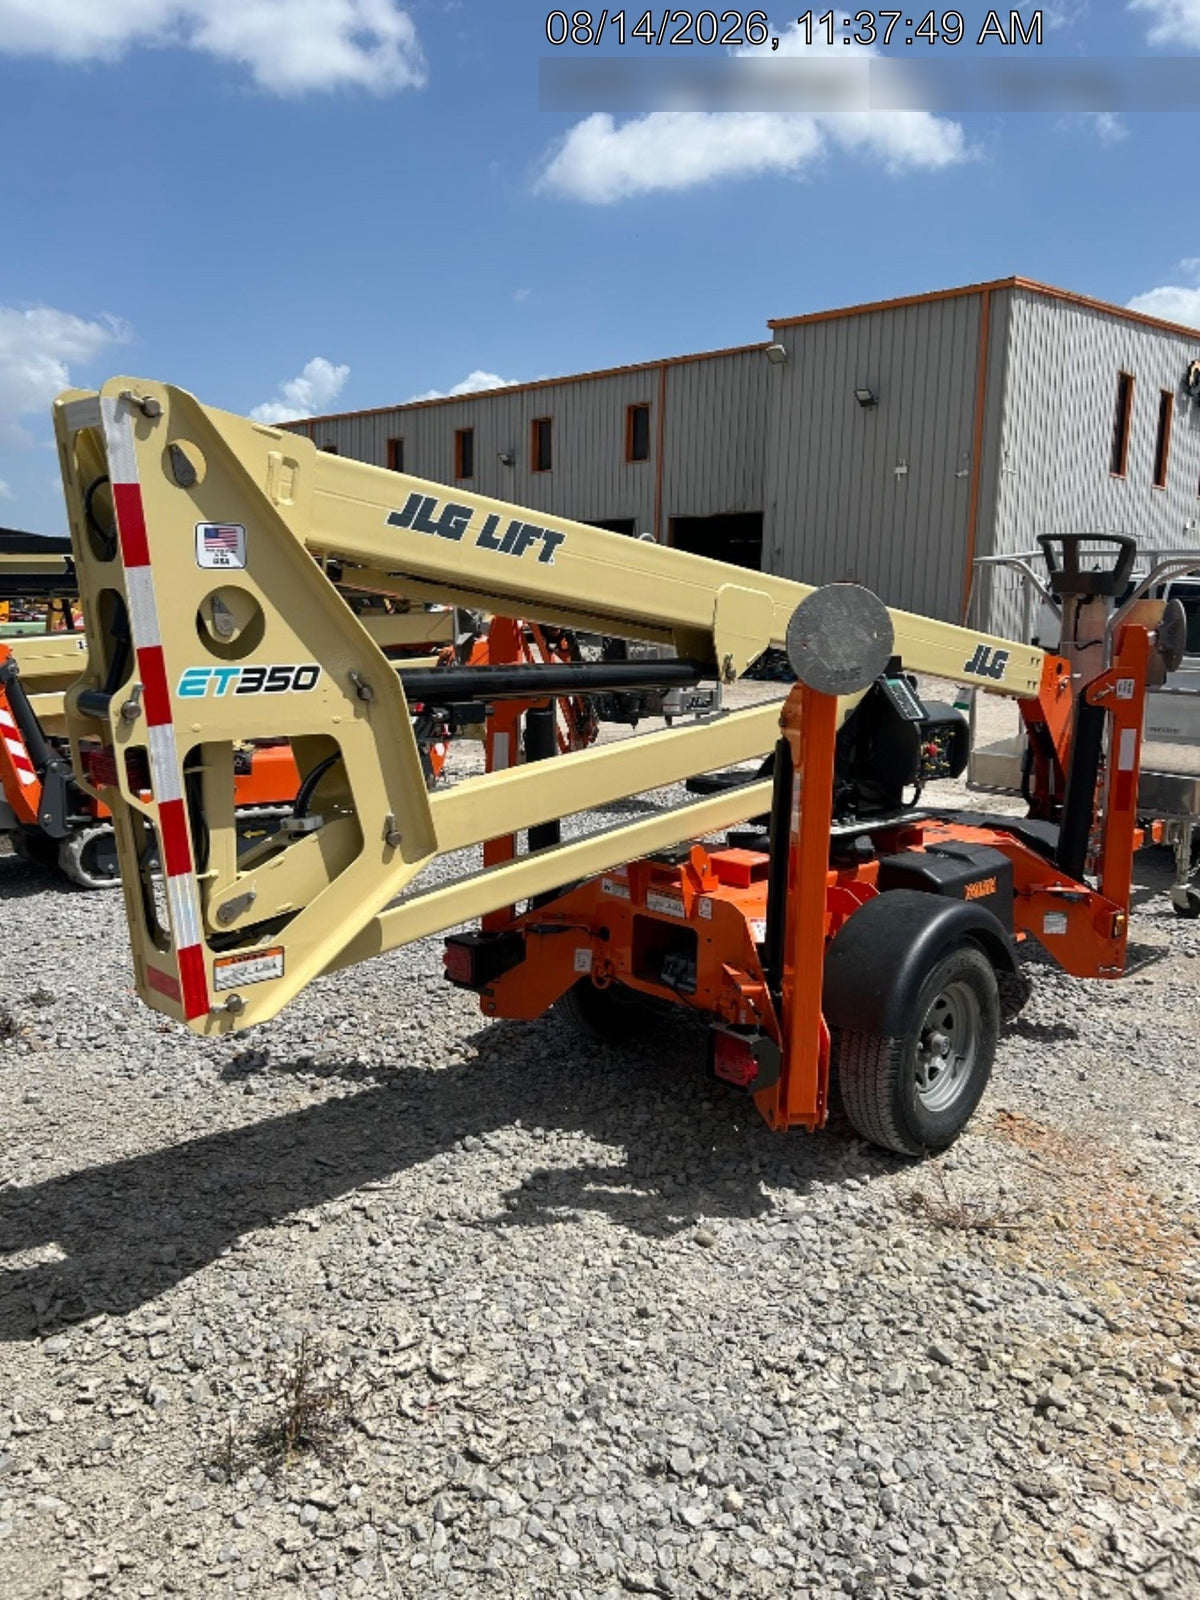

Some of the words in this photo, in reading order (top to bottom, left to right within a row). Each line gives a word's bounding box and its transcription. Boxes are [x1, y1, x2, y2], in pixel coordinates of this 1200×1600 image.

[387, 492, 474, 542] JLG
[475, 513, 566, 564] LIFT
[178, 664, 322, 697] ET350
[963, 643, 1010, 681] JLG
